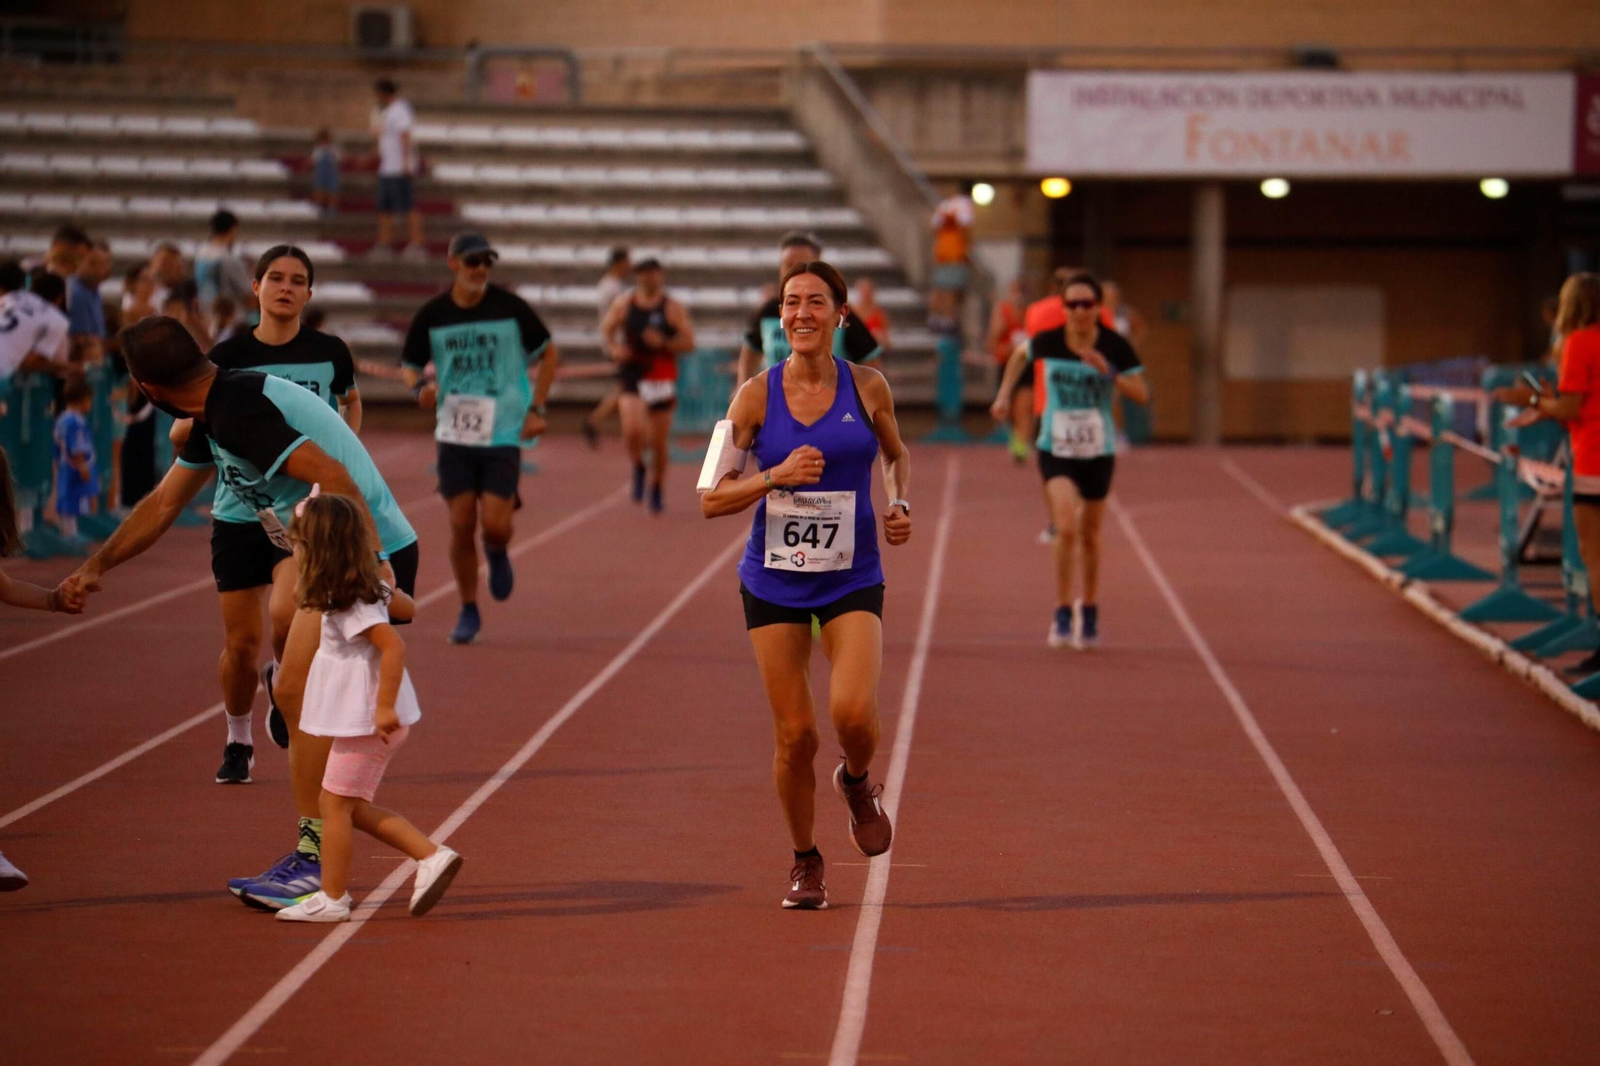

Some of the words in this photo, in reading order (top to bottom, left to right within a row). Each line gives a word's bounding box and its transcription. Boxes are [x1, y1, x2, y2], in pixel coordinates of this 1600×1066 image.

[1243, 86, 1381, 110] DEPORTIVA
[1389, 86, 1525, 111] MUNICIPAL
[1184, 114, 1410, 162] FONTANAR
[451, 410, 483, 434] 152
[783, 521, 839, 549] 647
